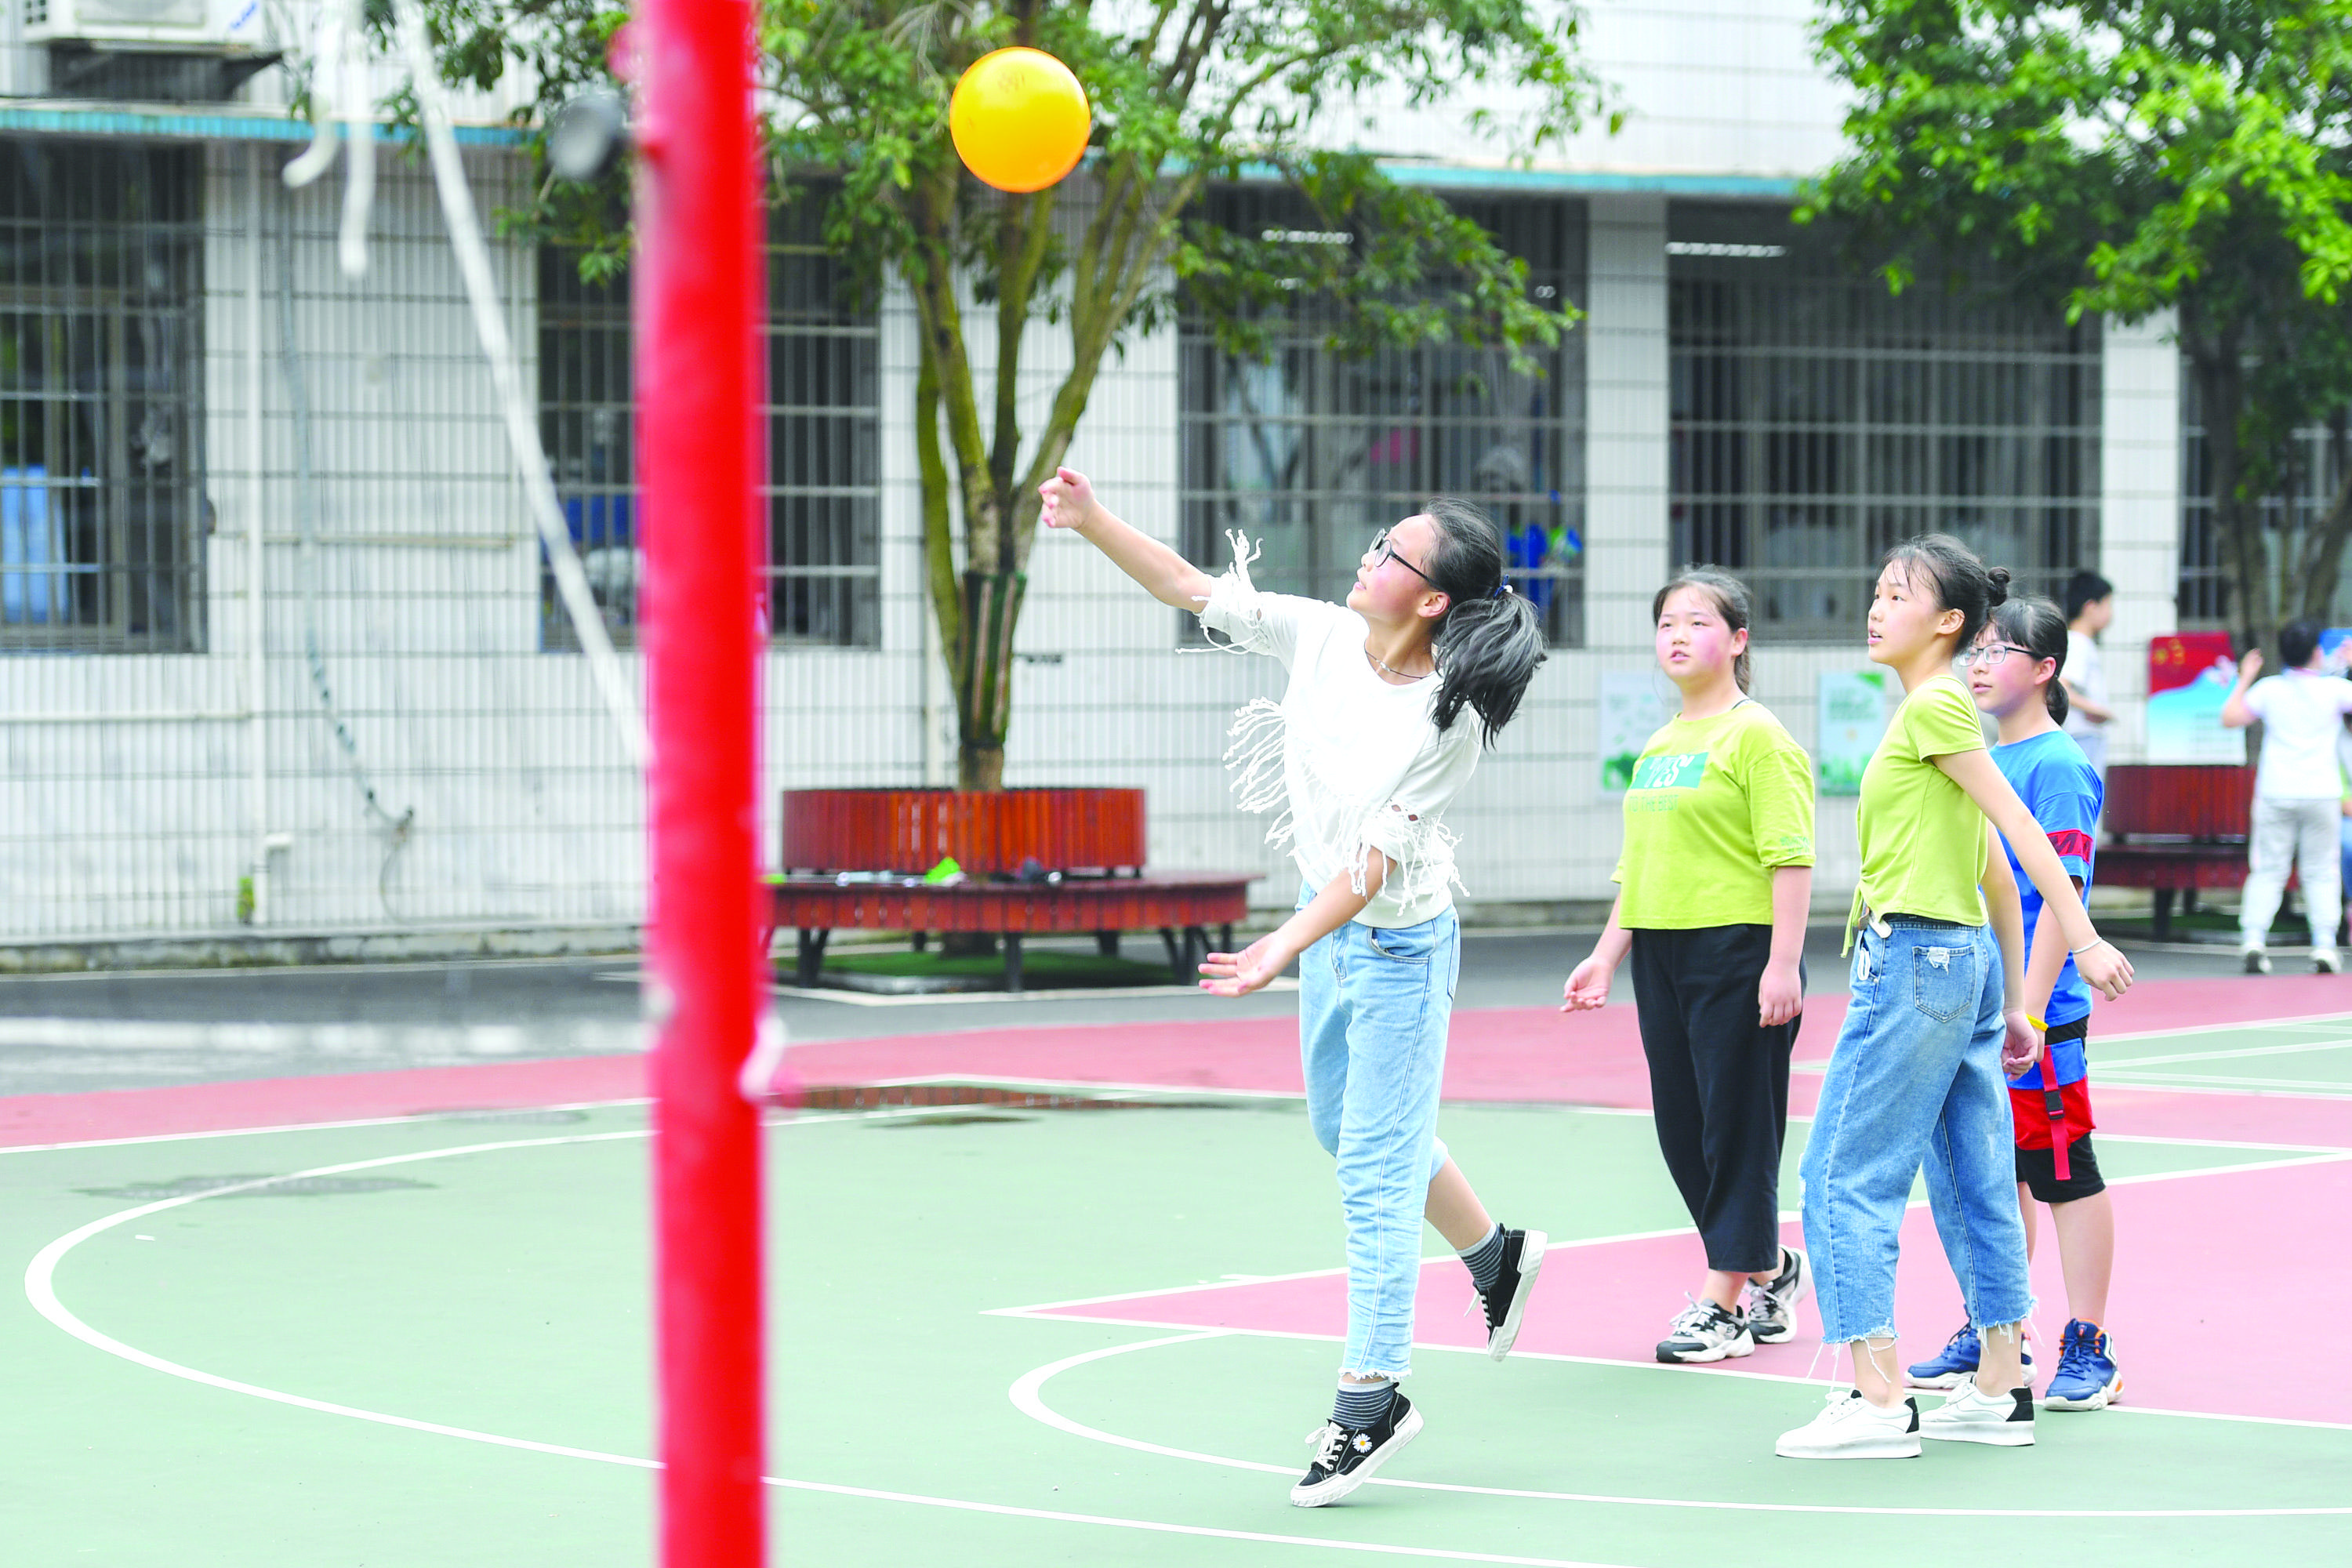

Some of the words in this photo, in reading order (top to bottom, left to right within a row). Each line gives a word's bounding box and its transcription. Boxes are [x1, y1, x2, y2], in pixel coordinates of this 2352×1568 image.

[1628, 796, 1638, 812] TO
[1640, 796, 1655, 812] THE
[1657, 794, 1679, 811] BEST
